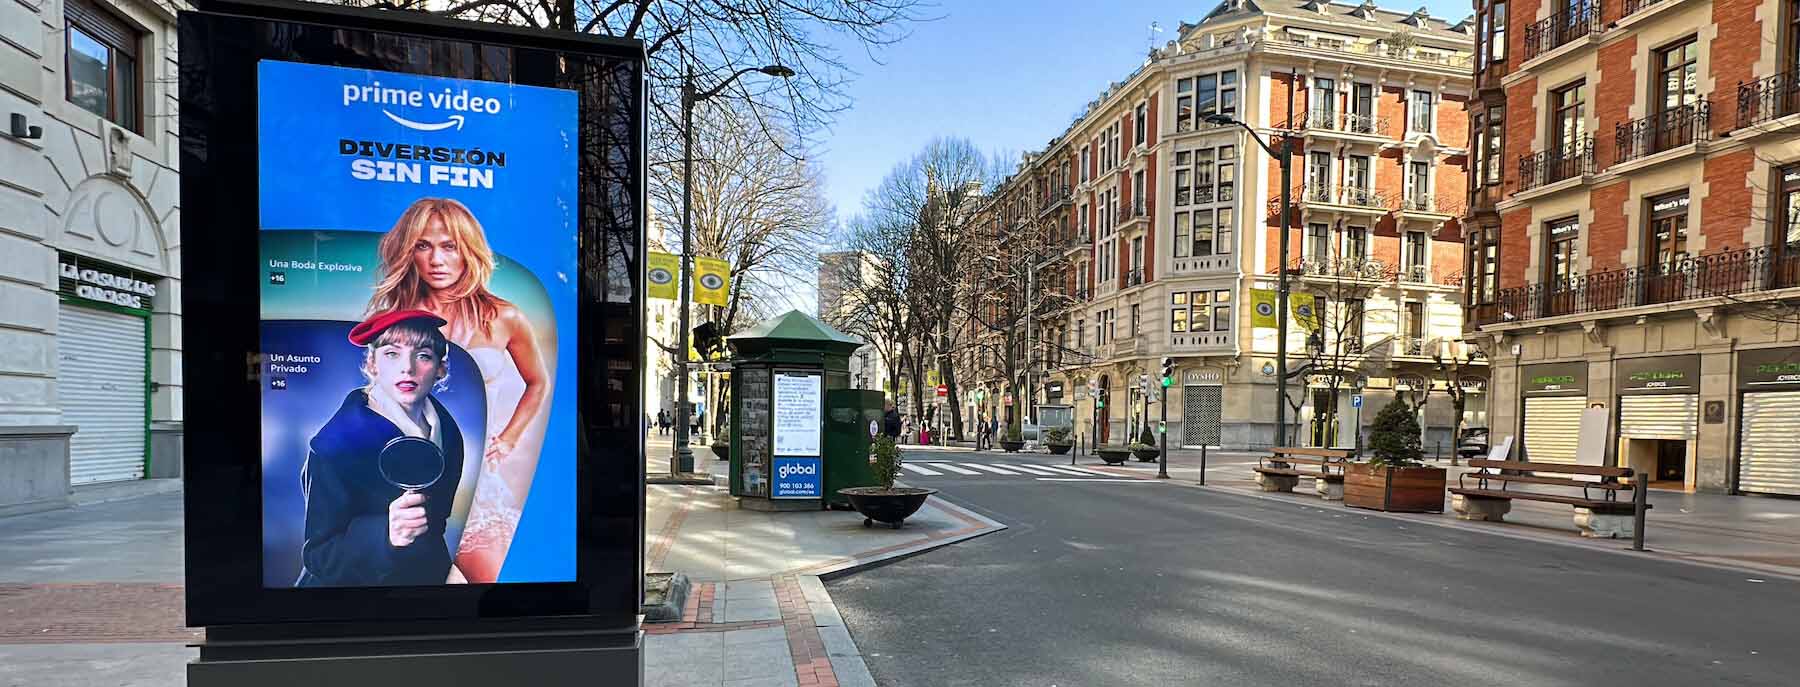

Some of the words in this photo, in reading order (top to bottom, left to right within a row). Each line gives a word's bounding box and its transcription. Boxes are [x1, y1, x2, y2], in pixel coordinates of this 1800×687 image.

[343, 81, 423, 106] prime
[428, 88, 501, 114] video
[339, 138, 506, 167] DIVERSIÓN
[351, 158, 421, 184] SIN
[429, 165, 494, 189] FIN
[269, 259, 289, 269] Una
[291, 260, 315, 270] Boda
[318, 261, 363, 273] Explosiva
[60, 262, 80, 280] LA
[80, 269, 115, 288] CASA
[134, 280, 156, 297] LAS
[270, 353, 285, 362] Un
[286, 354, 321, 363] Asunto
[270, 364, 308, 373] Privado
[1354, 396, 1361, 406] P
[779, 463, 816, 478] global
